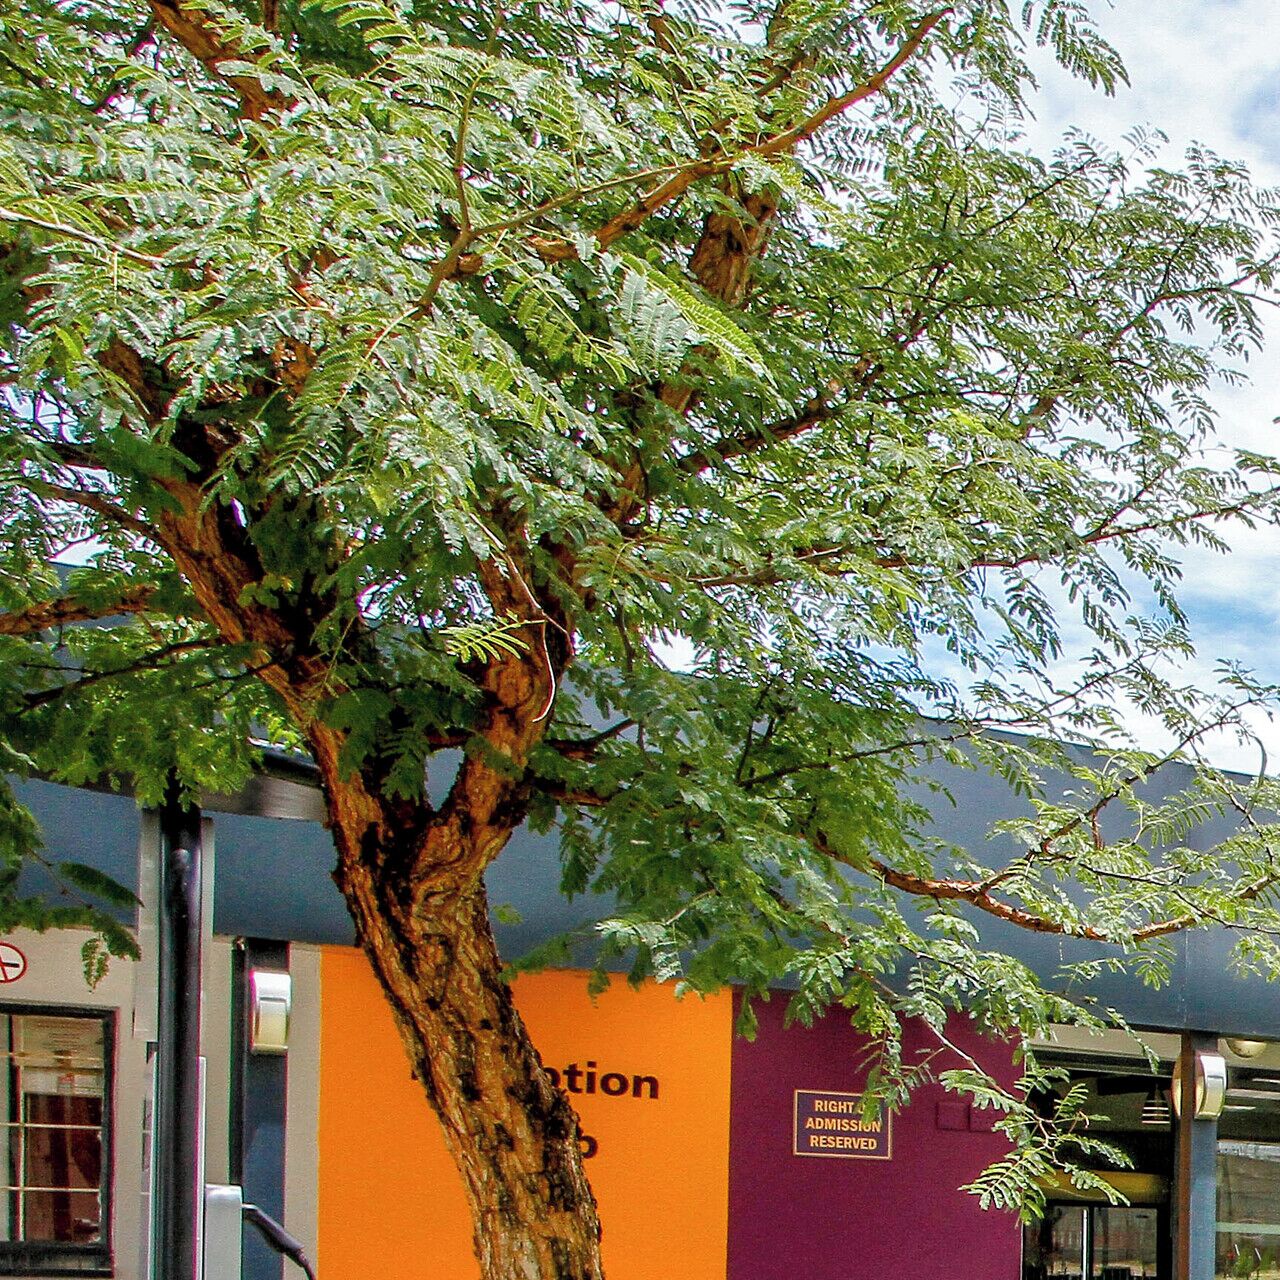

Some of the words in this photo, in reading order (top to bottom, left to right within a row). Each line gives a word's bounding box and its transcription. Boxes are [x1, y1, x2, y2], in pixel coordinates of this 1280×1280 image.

[814, 1100, 854, 1114] RIGHT
[805, 1117, 881, 1133] ADMISSION
[810, 1135, 877, 1150] RESERVED
